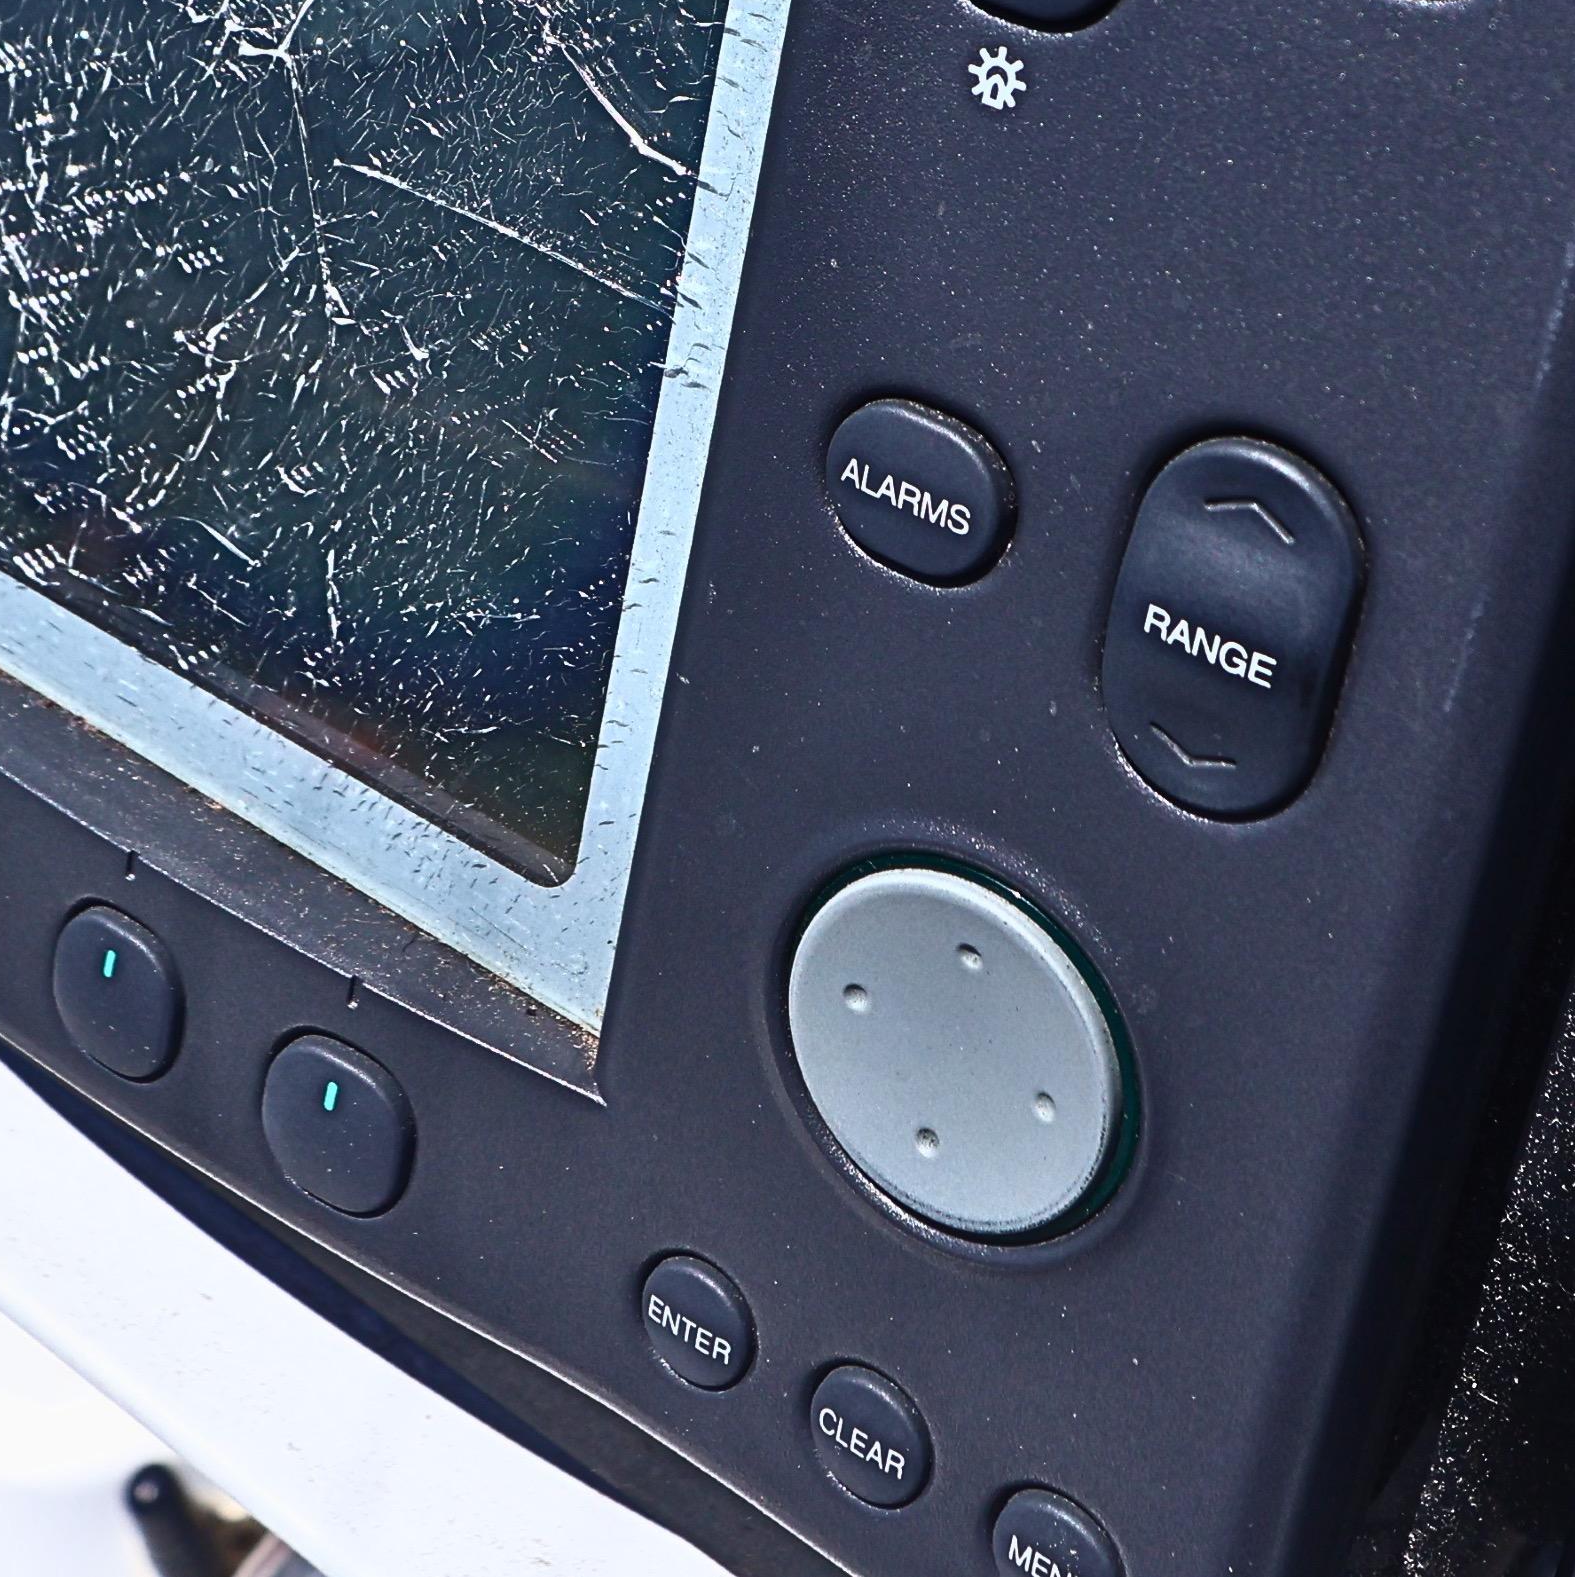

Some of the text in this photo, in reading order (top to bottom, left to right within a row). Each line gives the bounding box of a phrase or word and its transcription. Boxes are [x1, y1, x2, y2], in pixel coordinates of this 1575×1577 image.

[840, 457, 971, 535] ALARMS
[1143, 604, 1277, 688] RANGE
[648, 1294, 732, 1365] ENTER
[819, 1408, 905, 1480] CLEAR
